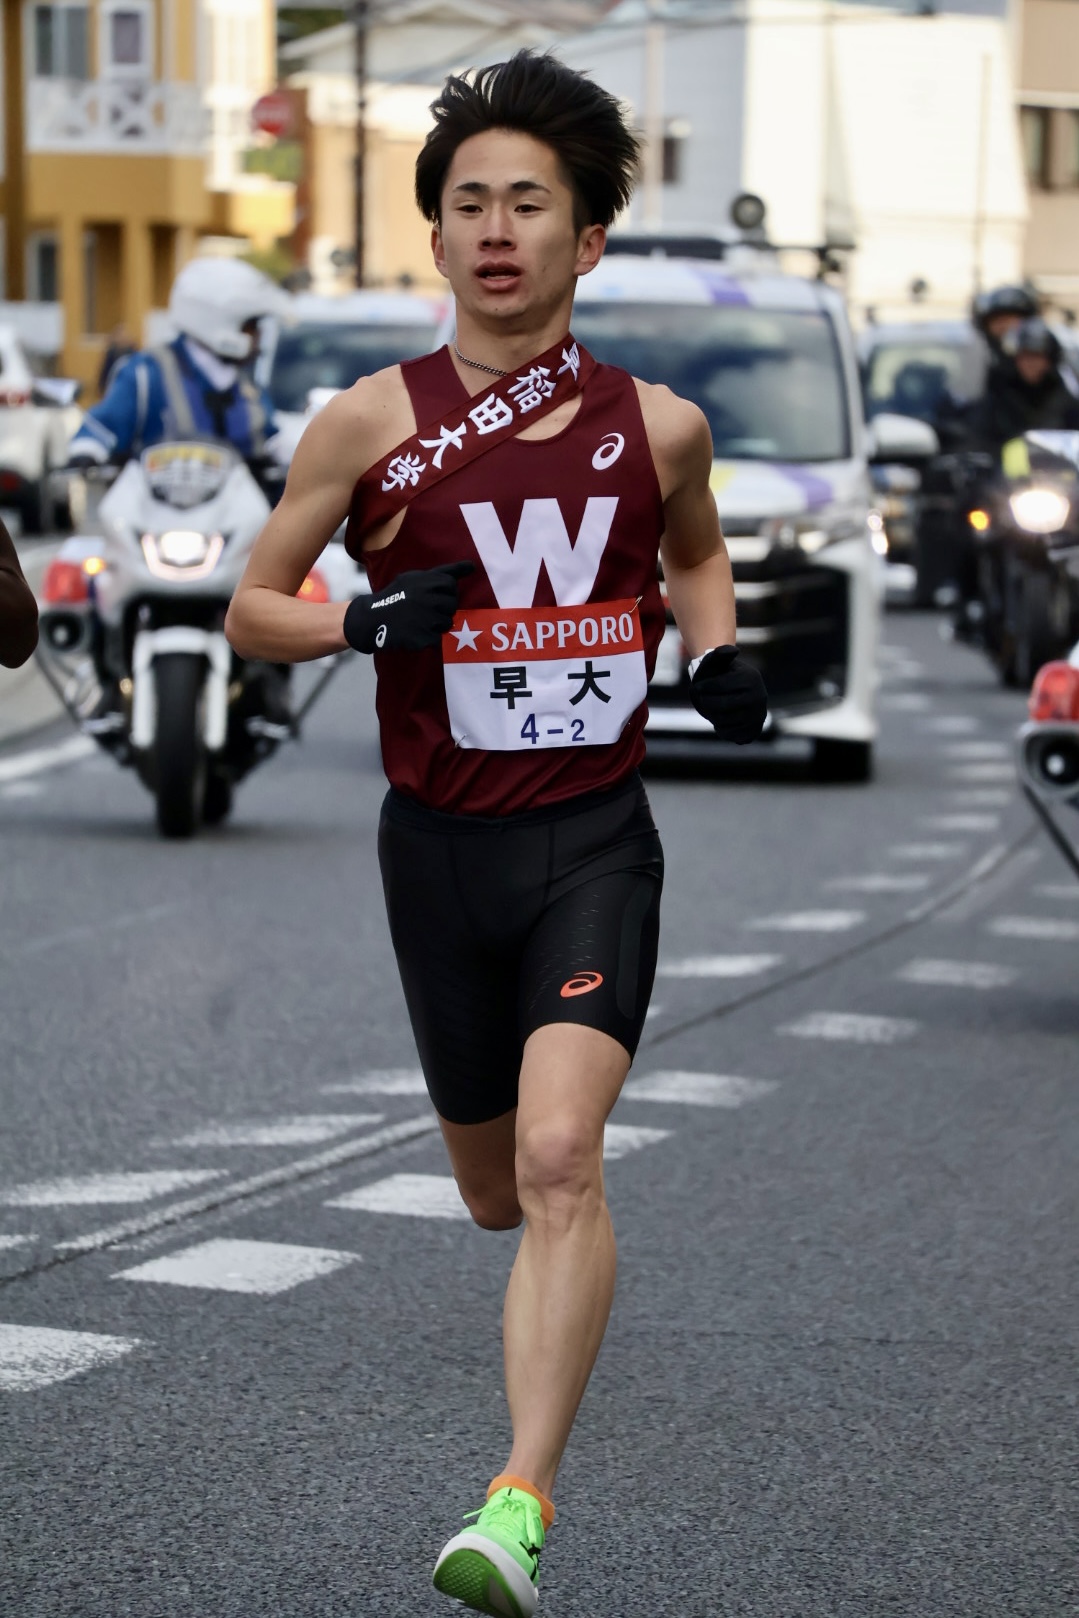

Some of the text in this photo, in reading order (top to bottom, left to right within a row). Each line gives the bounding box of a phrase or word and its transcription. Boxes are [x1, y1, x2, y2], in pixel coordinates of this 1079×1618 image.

[381, 342, 581, 492] 早稲田大学
[459, 496, 620, 609] W
[371, 591, 406, 609] WASEDA
[491, 612, 634, 652] SAPPORO
[520, 713, 586, 745] 4-2
